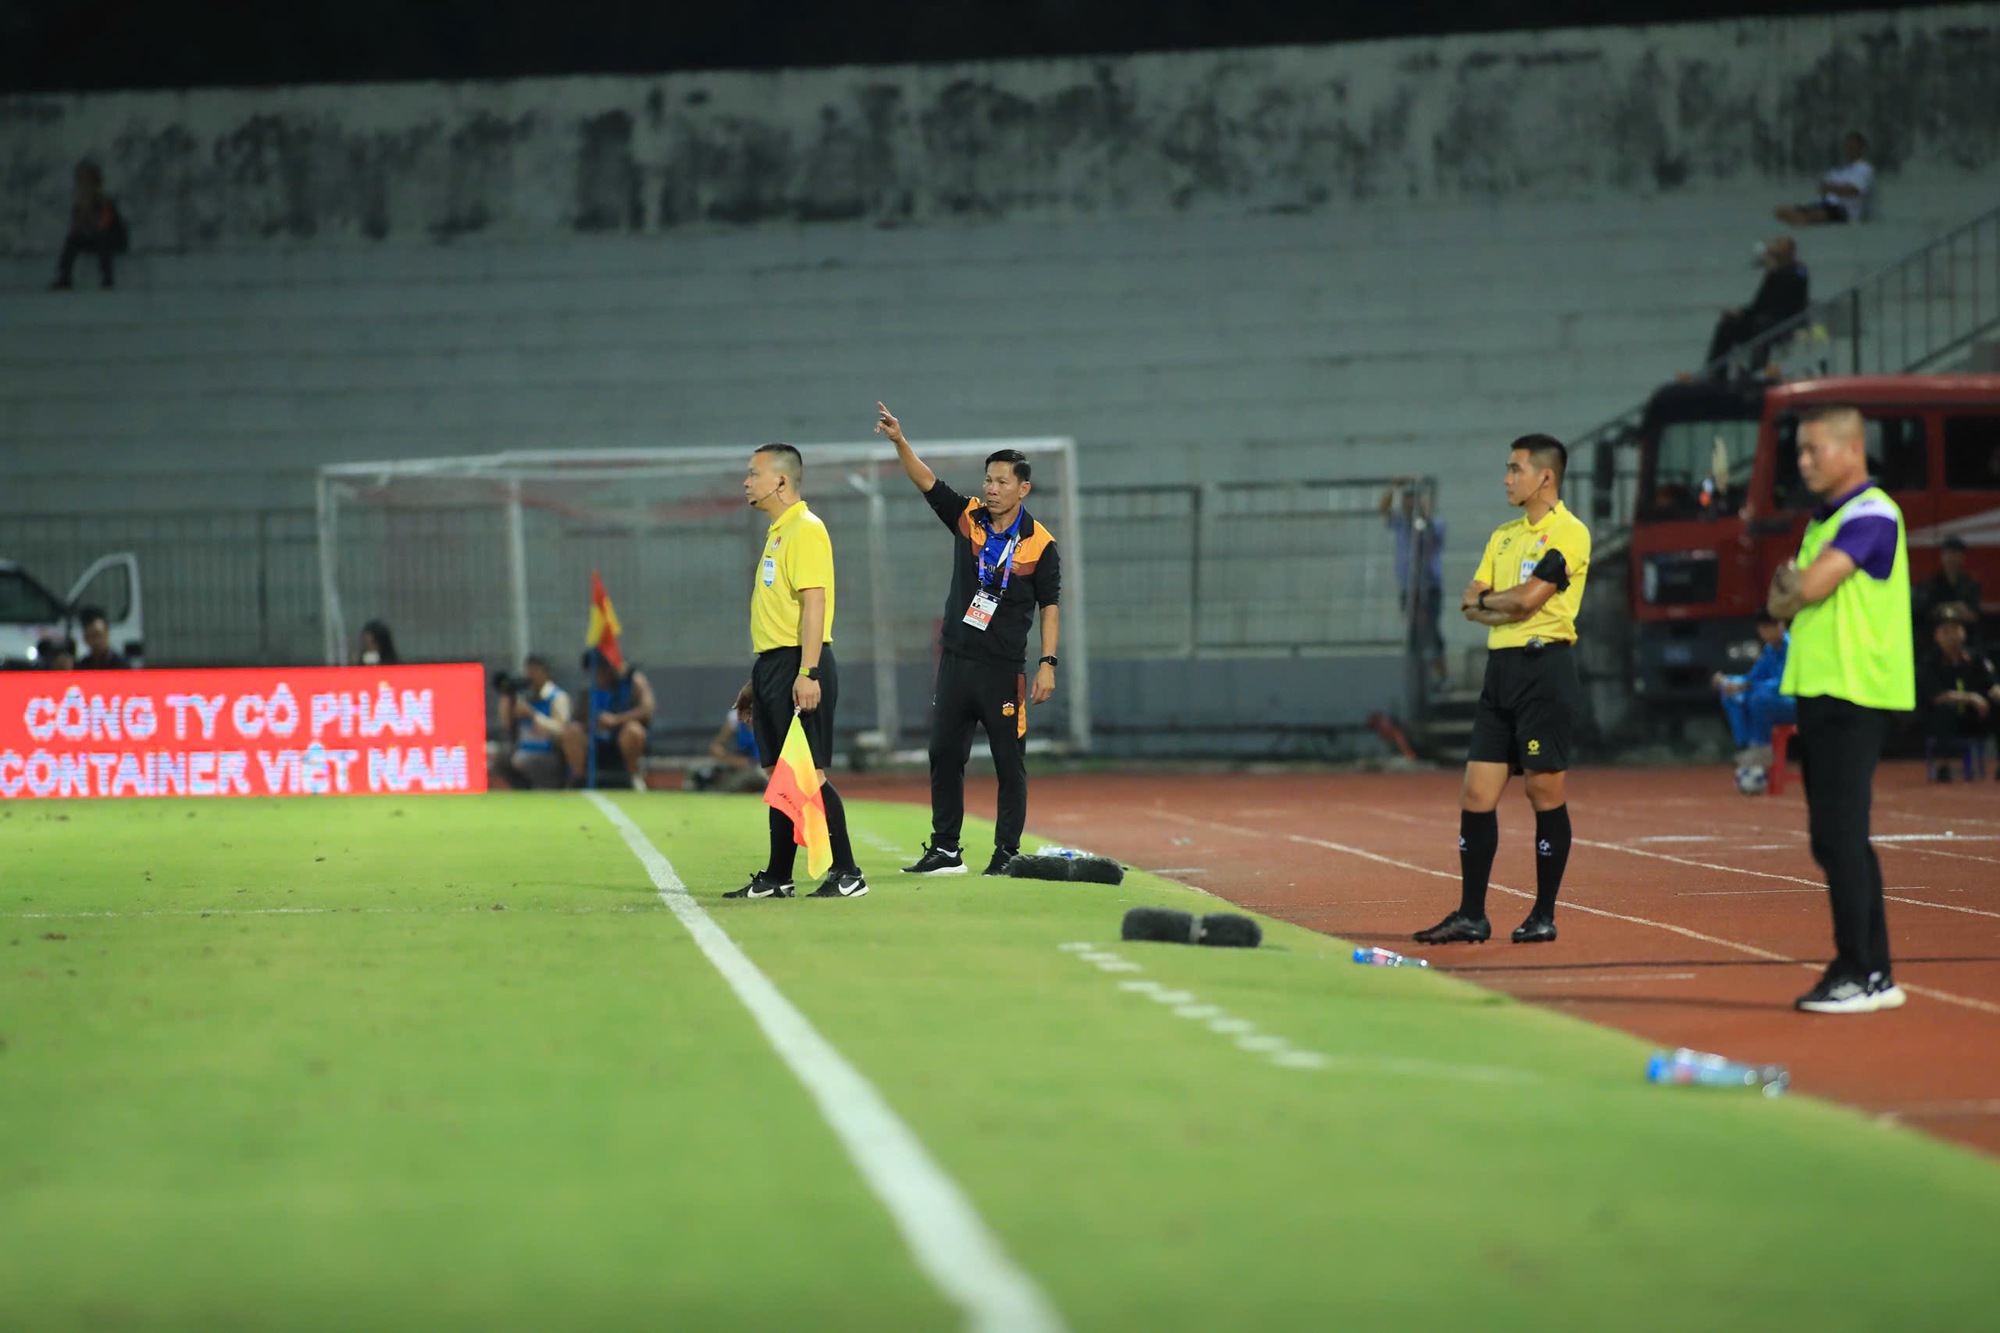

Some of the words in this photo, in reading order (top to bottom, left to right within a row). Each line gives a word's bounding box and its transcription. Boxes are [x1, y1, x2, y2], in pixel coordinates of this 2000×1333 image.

[24, 684, 157, 741] CÔNG
[165, 694, 226, 740] TY
[0, 749, 250, 798] CONTAINER
[368, 745, 469, 792] NAM
